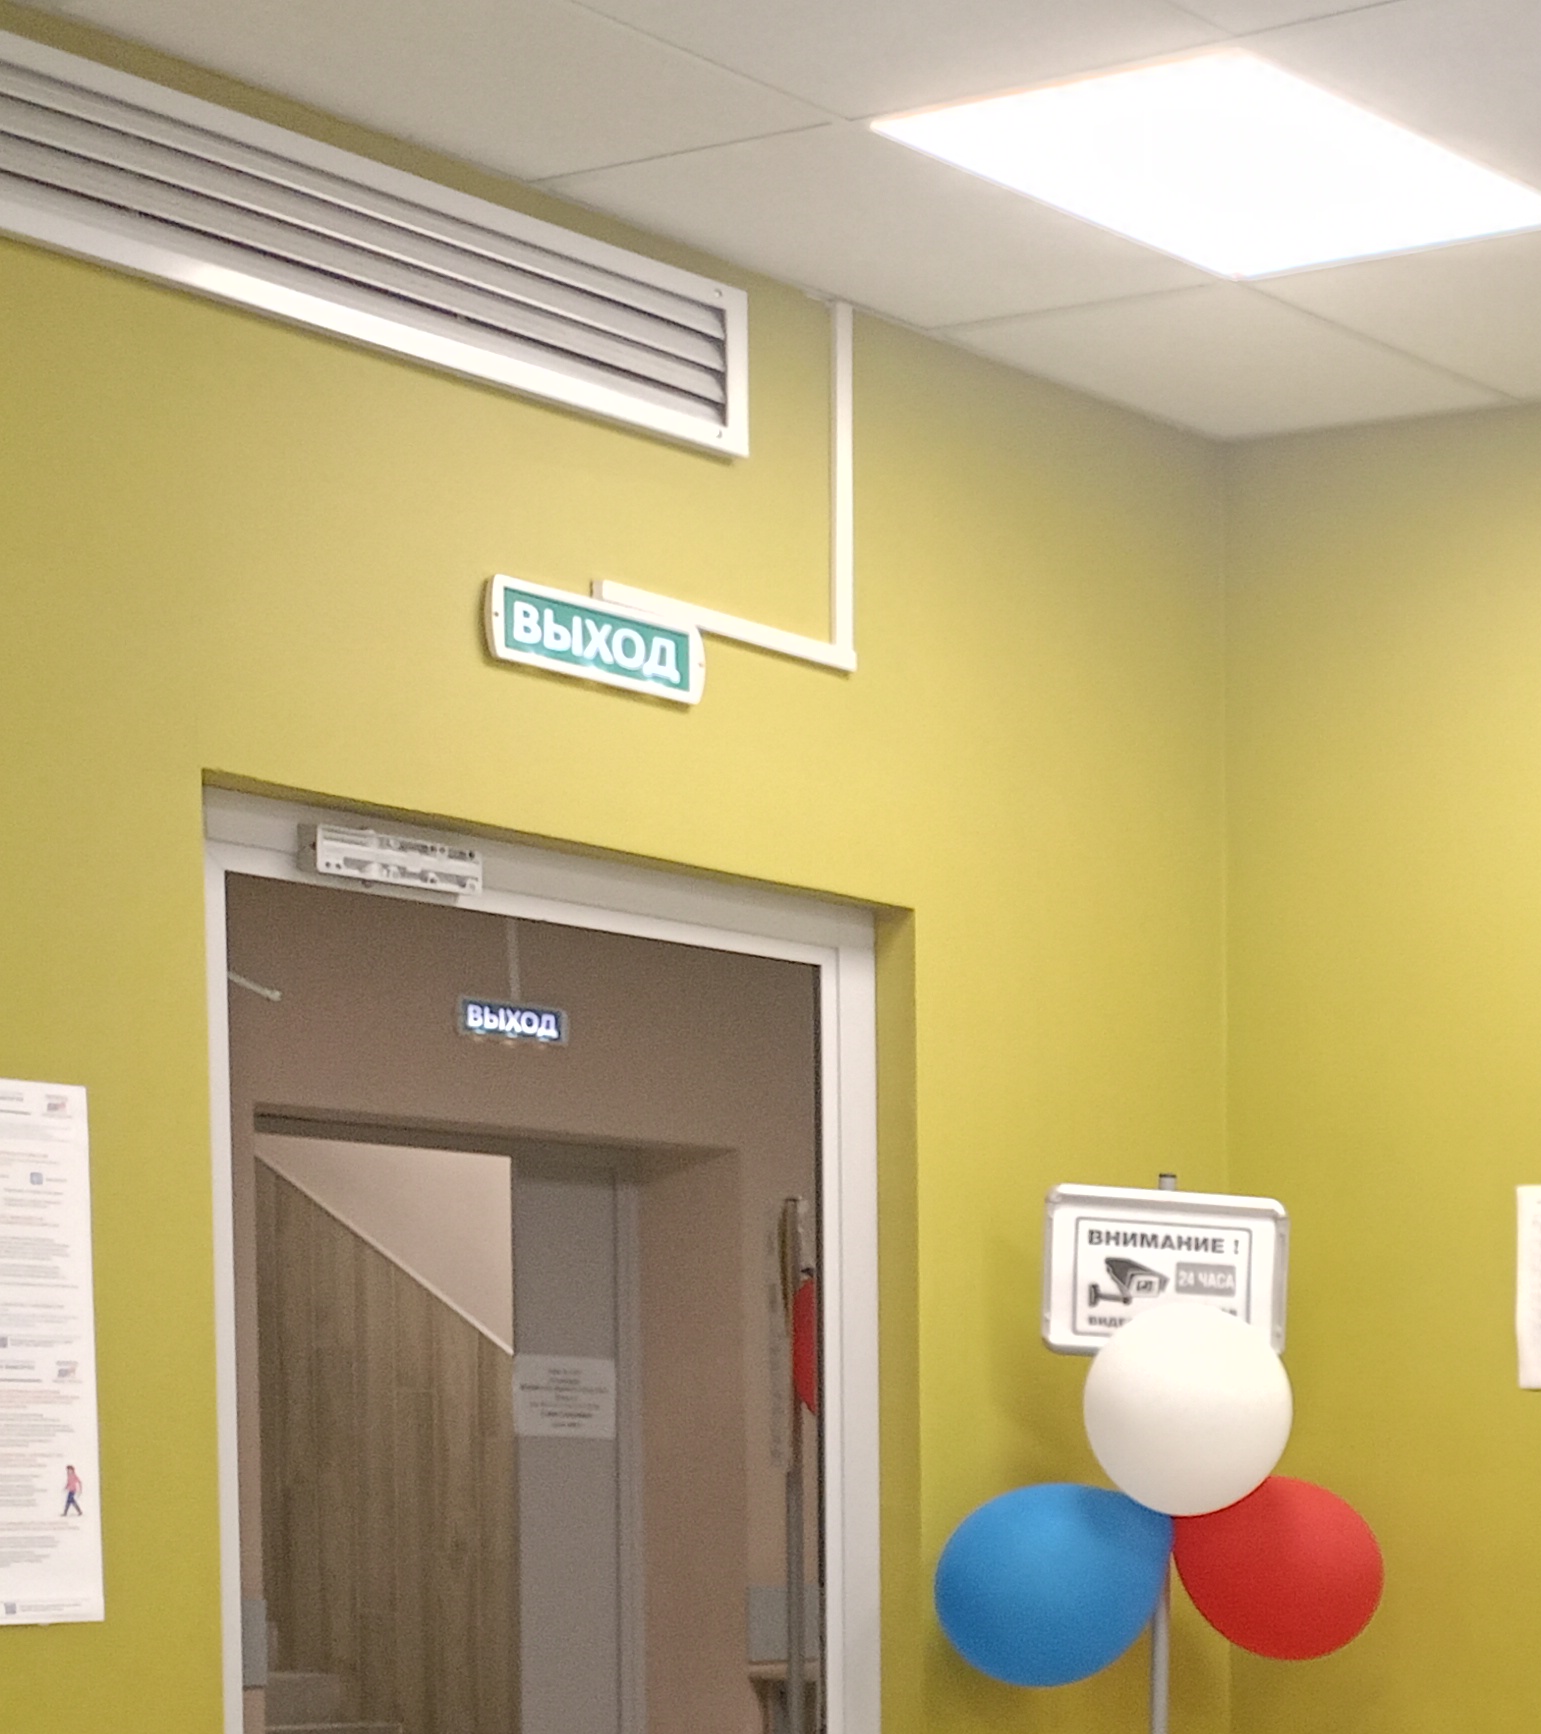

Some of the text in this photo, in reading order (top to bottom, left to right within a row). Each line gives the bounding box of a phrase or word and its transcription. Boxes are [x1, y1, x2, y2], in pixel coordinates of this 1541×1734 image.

[512, 600, 681, 684] ВЫХОД
[466, 1003, 560, 1040] ВЫХОД
[1088, 1229, 1225, 1254] ВНИМАНИЕ
[1178, 1271, 1236, 1290] 24 ЧАСА
